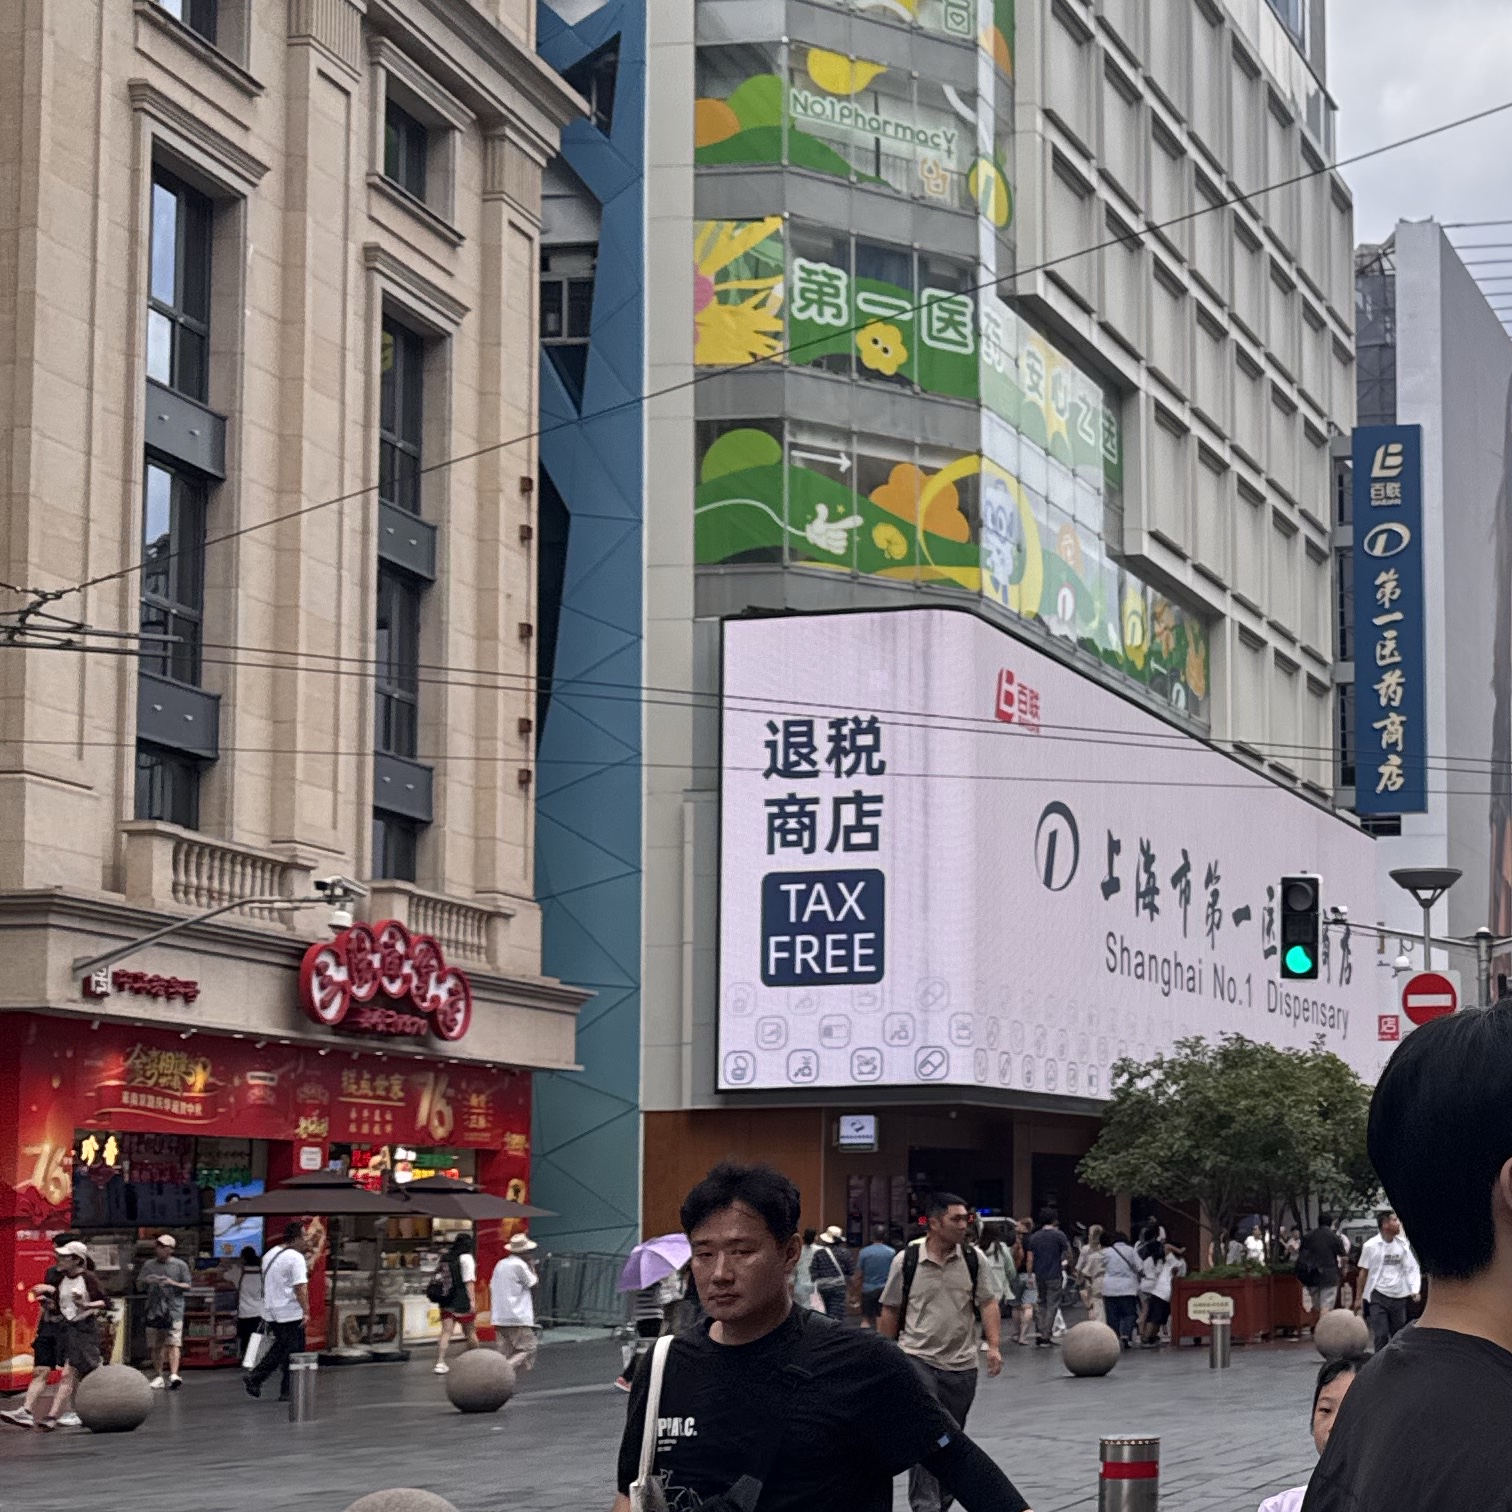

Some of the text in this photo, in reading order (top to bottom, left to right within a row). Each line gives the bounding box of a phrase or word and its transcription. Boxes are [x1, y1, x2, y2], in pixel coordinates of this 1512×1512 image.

[1371, 567, 1407, 794] 第一医药商店
[762, 715, 886, 780] 退税
[764, 789, 884, 855] 商店
[779, 881, 866, 923] TAX
[768, 932, 877, 976] FREE
[1105, 931, 1349, 1041] Shanghai No.1 Dispensary
